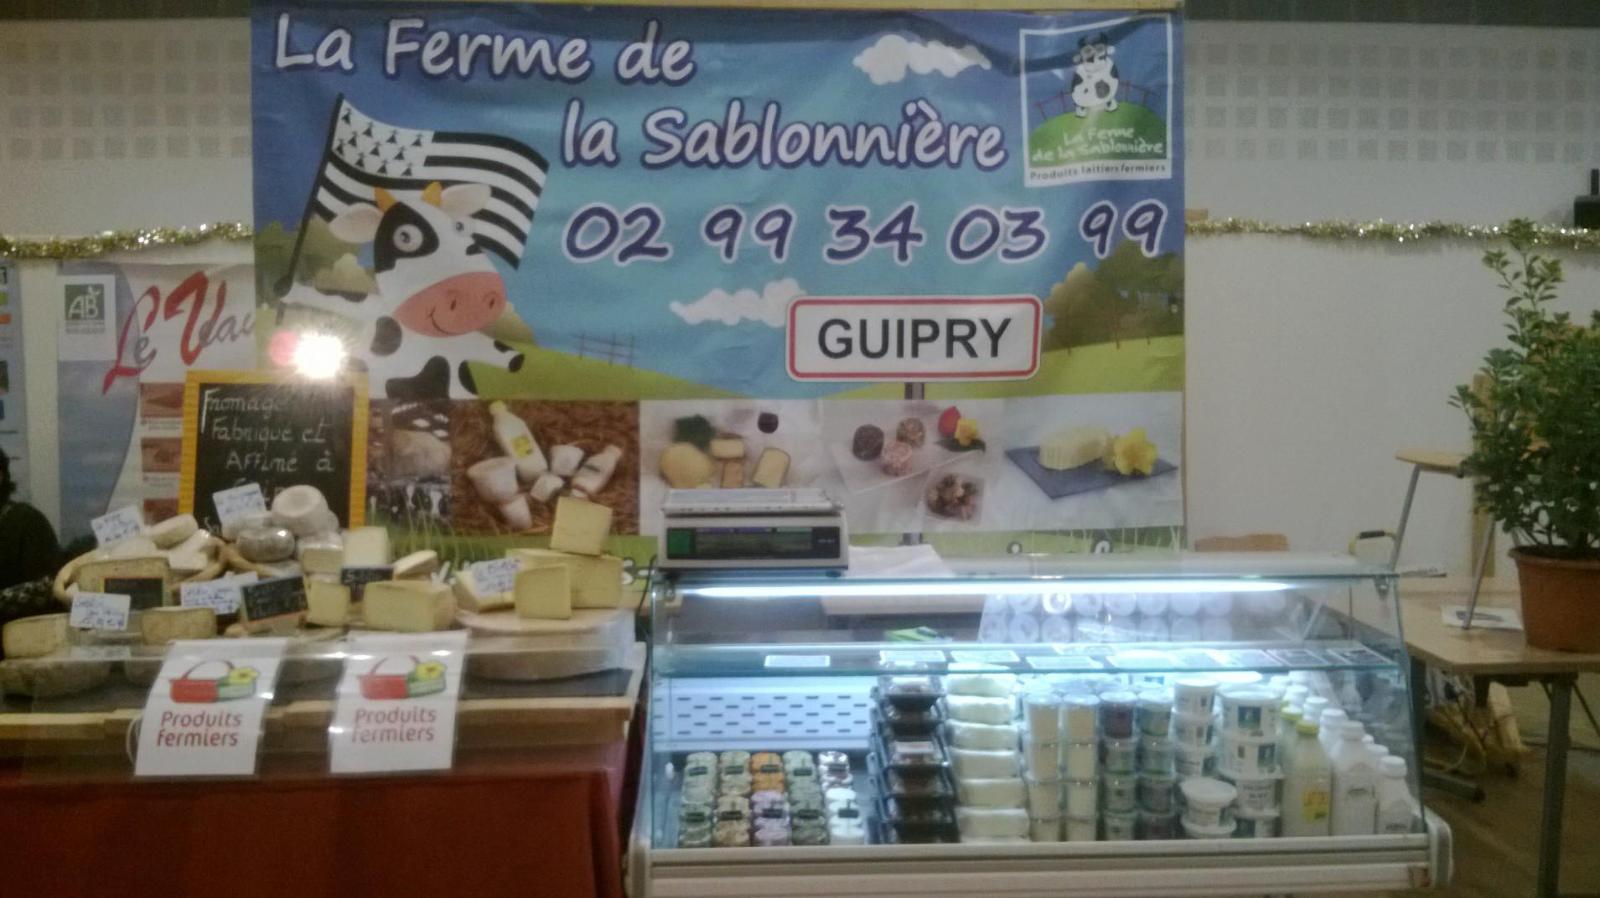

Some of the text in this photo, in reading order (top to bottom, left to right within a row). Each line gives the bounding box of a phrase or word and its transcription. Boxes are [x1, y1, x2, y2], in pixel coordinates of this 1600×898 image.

[274, 12, 696, 83] La Ferme de
[562, 98, 1008, 170] la Sablonnière
[1063, 127, 1135, 146] La Ferme
[1030, 168, 1078, 180] Produits
[563, 200, 1167, 265] 02 99 34 03 99
[103, 284, 162, 395] Le
[817, 317, 1012, 361] GUIPRY
[160, 709, 243, 729] Produits
[355, 706, 437, 726] Produits
[157, 729, 238, 747] fermiers
[352, 724, 434, 745] fermiers
